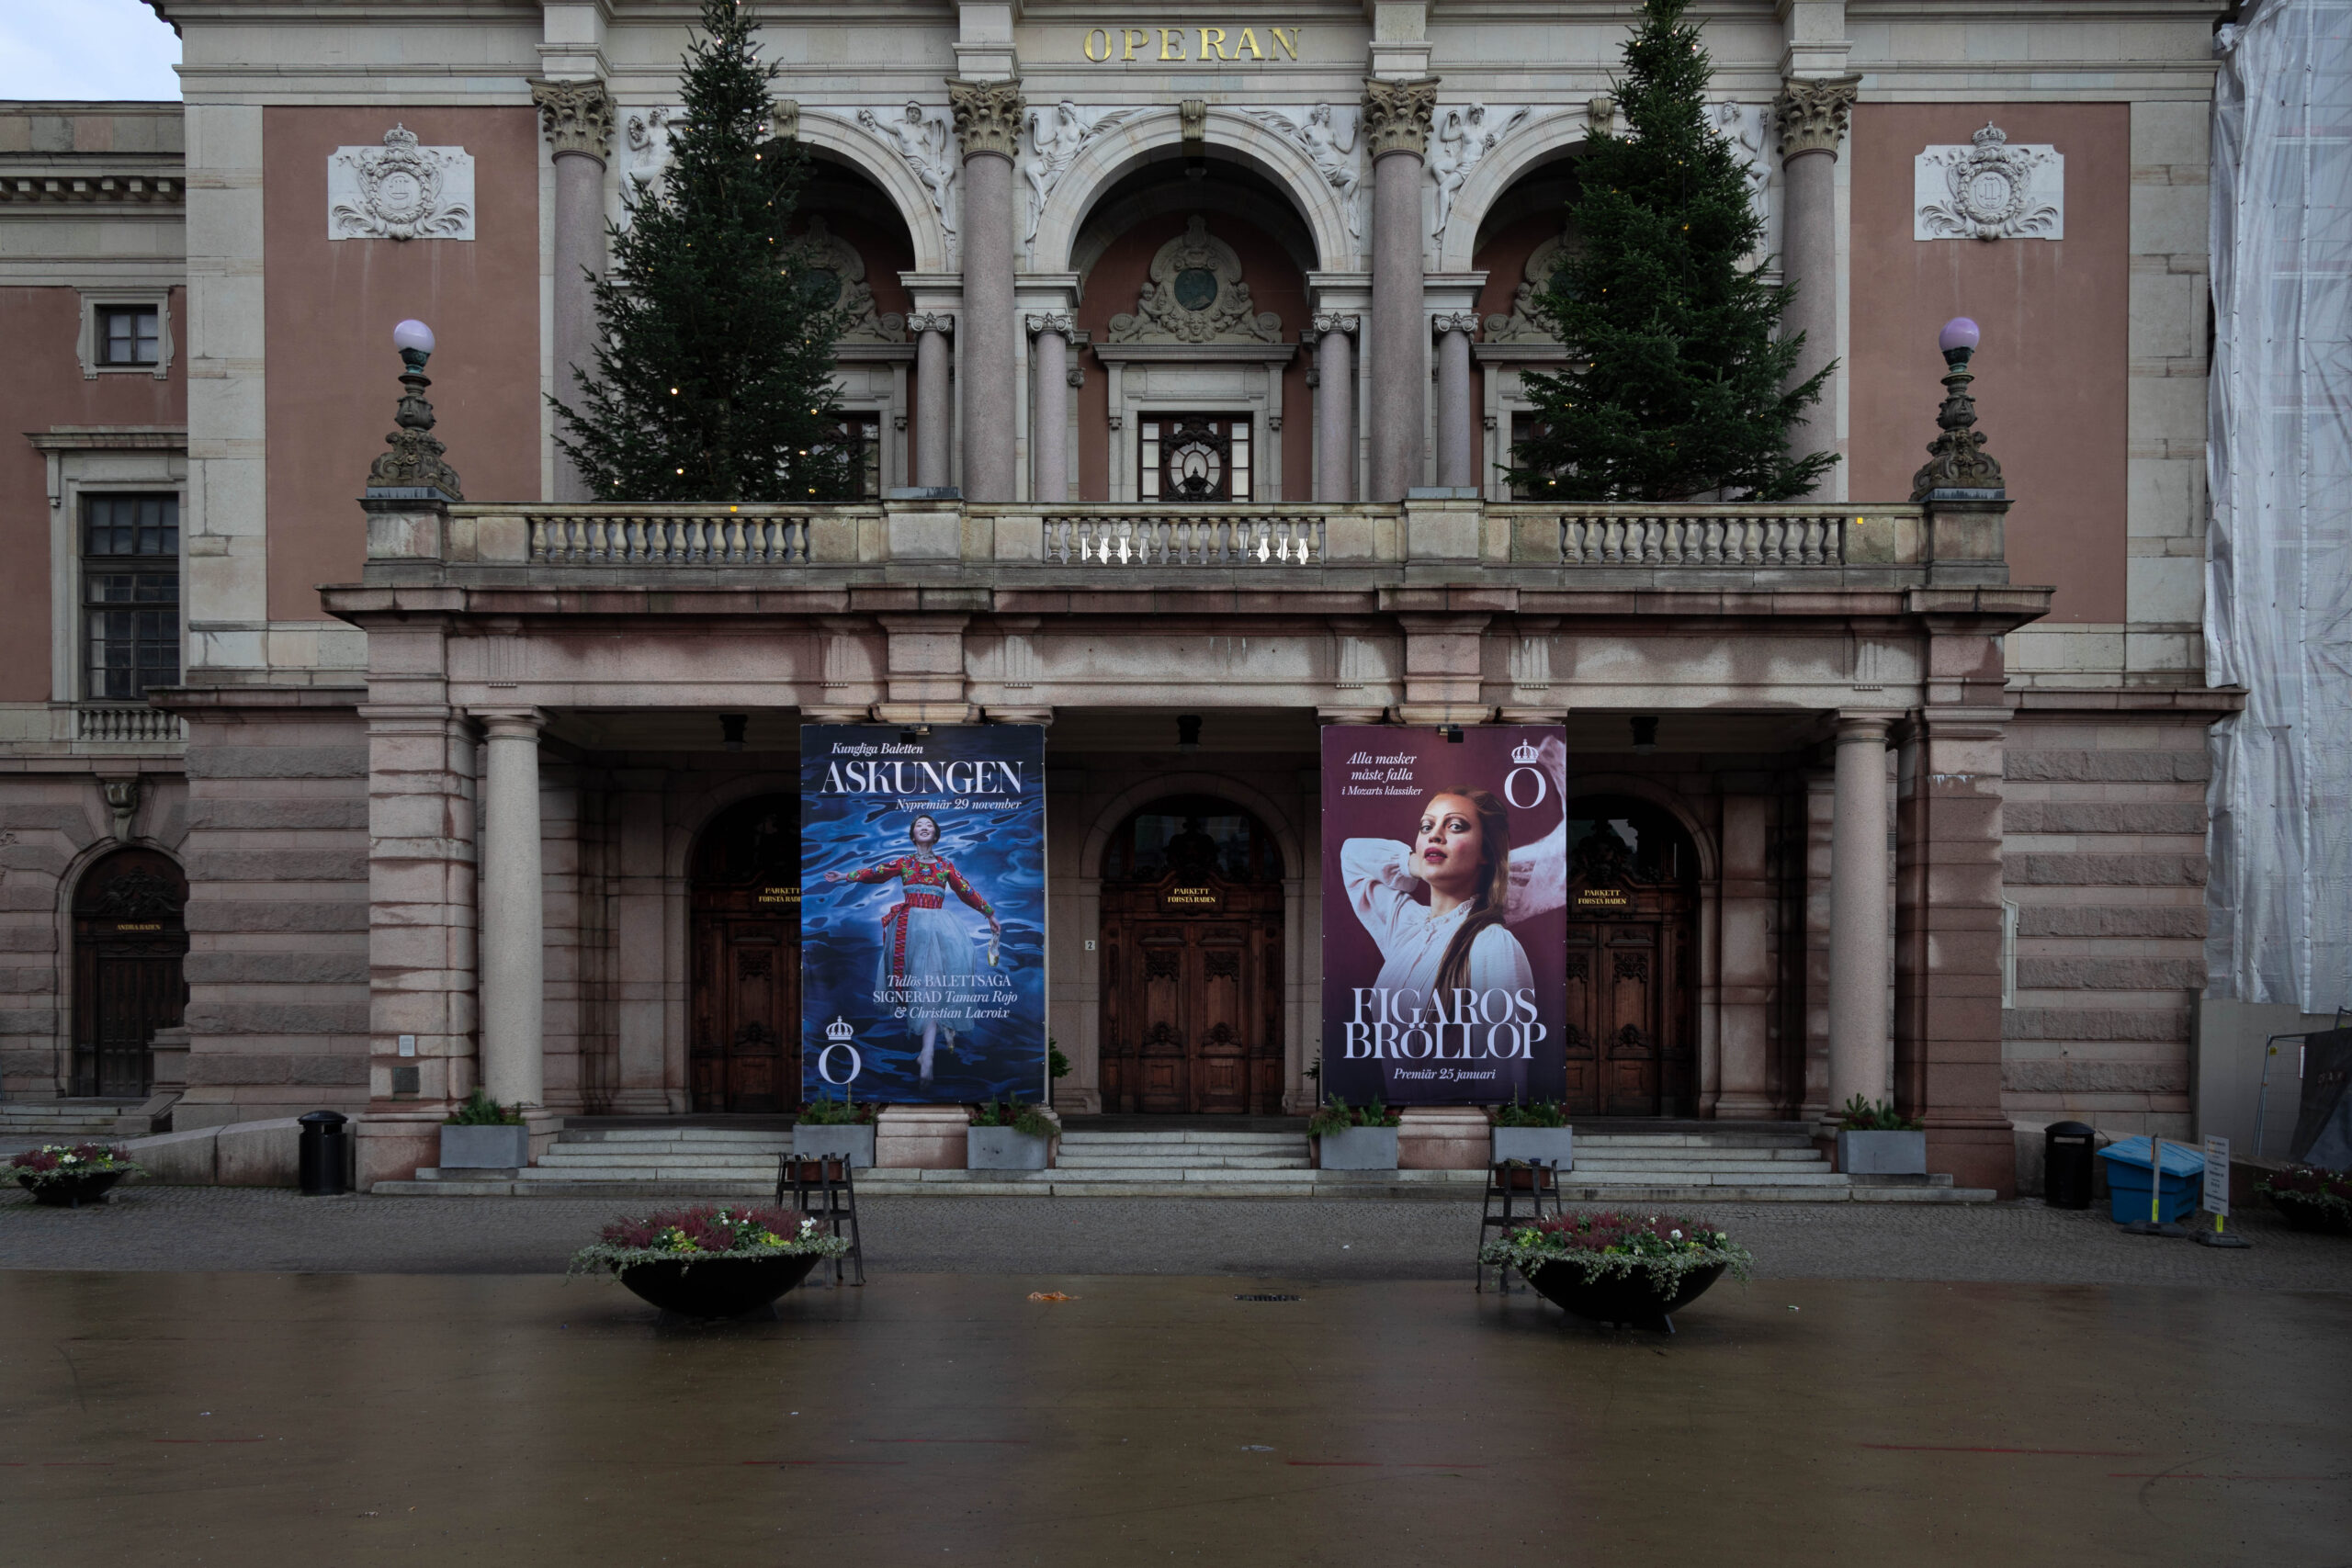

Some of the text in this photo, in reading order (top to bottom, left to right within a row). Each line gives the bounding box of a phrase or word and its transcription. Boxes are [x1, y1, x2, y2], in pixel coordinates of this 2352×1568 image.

[1083, 27, 1301, 62] OPERAN
[831, 742, 923, 757] Kungliga Baletten
[1346, 752, 1417, 764] Alla masker
[820, 761, 1023, 794] ASKUNGEN
[1351, 768, 1413, 784] måste falla
[1341, 786, 1422, 795] i Mozarts klassiker
[895, 798, 1022, 812] Nypremiär 29 november
[1087, 941, 1093, 950] 2
[887, 975, 1012, 987] Tidlös BALETTSAGA
[873, 990, 1018, 1006] SIGNERAD Tamara Rojo
[1351, 987, 1538, 1024] FIGAROS
[894, 1007, 1010, 1019] & Christian Lacroix
[1342, 1021, 1547, 1059] BRÖLLOP
[1393, 1067, 1497, 1082] Premiär 25 januari
